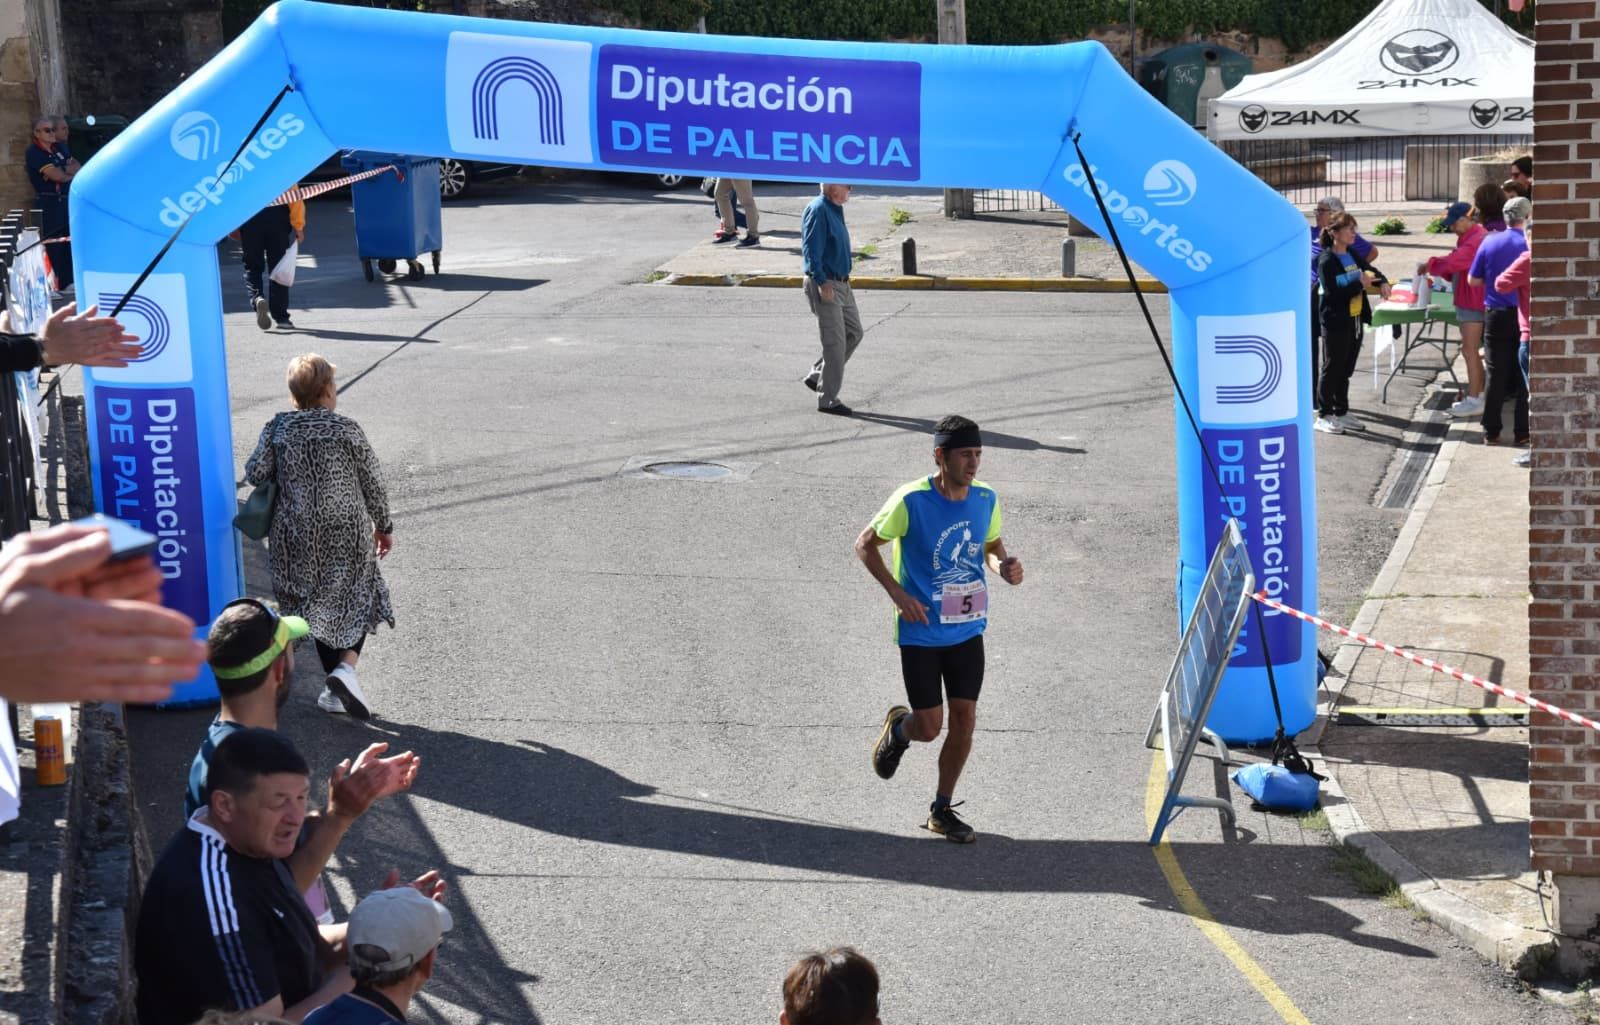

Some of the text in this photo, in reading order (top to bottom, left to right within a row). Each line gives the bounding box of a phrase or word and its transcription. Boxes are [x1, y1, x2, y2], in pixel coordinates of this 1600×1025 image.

[611, 64, 853, 115] Diputación
[1356, 77, 1480, 90] 24MX
[1270, 109, 1361, 126] 24MX
[611, 120, 913, 168] DE PALENCIA
[159, 112, 305, 228] deportes
[1063, 163, 1213, 272] deportes
[107, 398, 135, 445] DE
[1218, 439, 1245, 485] DE
[143, 399, 188, 579] Diputación
[1253, 436, 1289, 617] Diputación
[960, 594, 973, 615] 5
